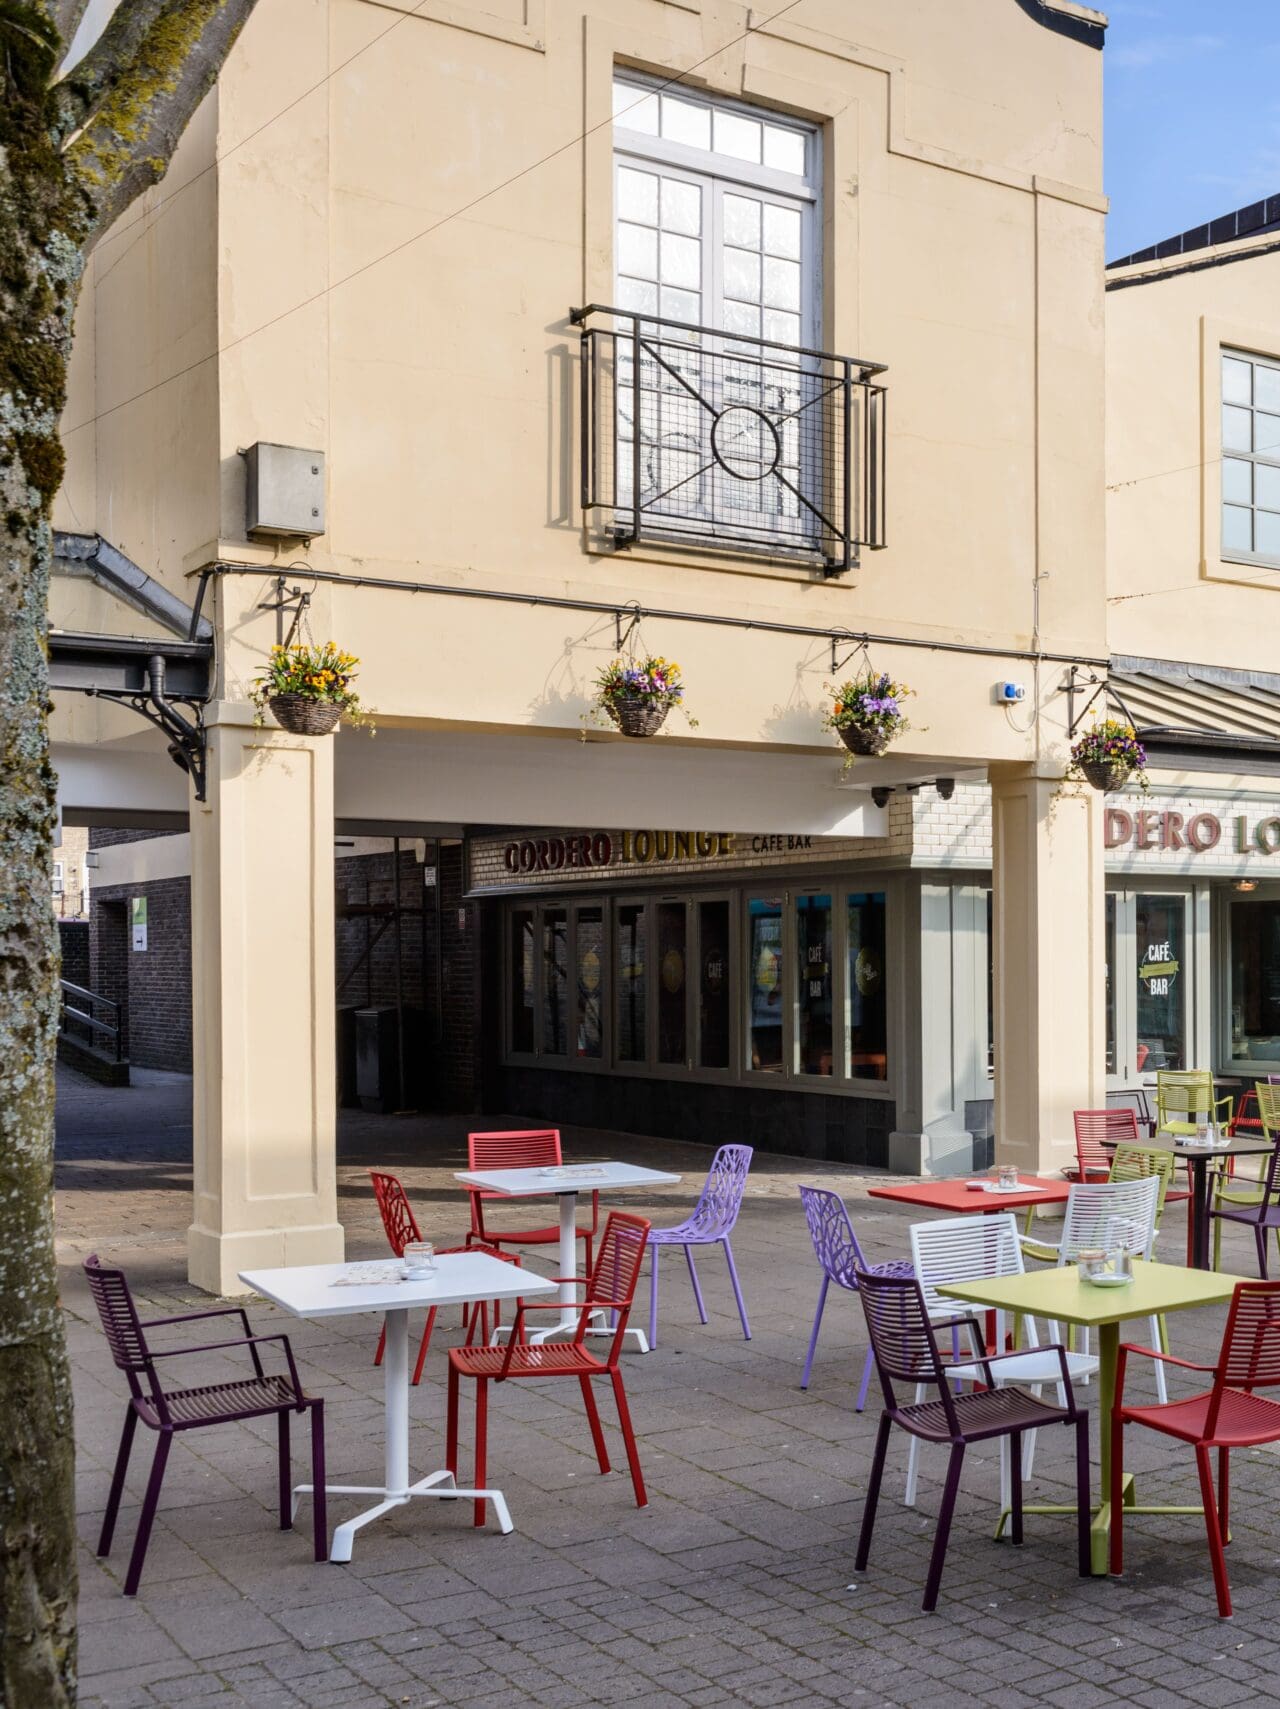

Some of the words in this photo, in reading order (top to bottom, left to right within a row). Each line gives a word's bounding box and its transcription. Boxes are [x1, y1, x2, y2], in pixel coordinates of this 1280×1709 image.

[504, 832, 612, 873] CORDERO
[622, 831, 735, 862] LOUNGE
[808, 944, 823, 963] CAFÉ
[1149, 941, 1170, 961] CAFÉ
[810, 980, 822, 997] BAR
[1150, 978, 1169, 995] BAR
